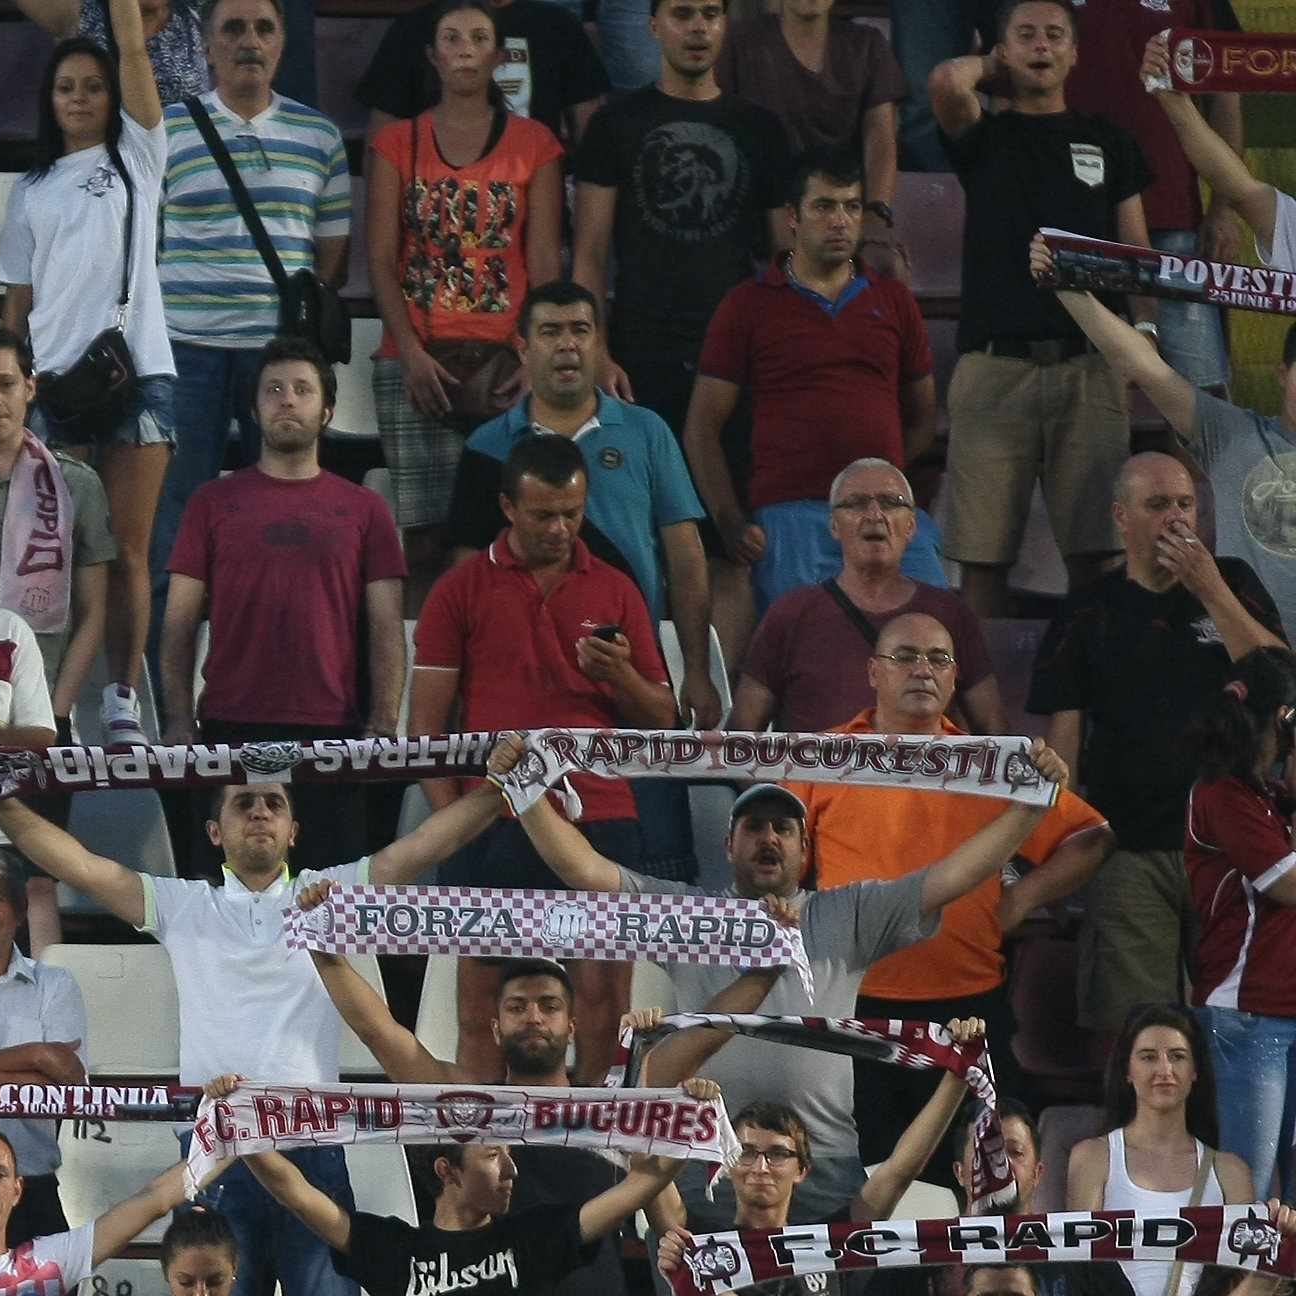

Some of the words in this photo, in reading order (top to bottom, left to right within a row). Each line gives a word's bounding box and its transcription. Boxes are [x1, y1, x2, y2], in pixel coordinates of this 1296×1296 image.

[544, 733, 706, 768] RAPID
[724, 735, 997, 784] BUCURESTI
[354, 903, 519, 940] FORZA
[615, 911, 778, 949] RAPID
[257, 1095, 405, 1139] RAPID
[770, 1228, 925, 1263] F.C.
[948, 1217, 1198, 1251] RAPID
